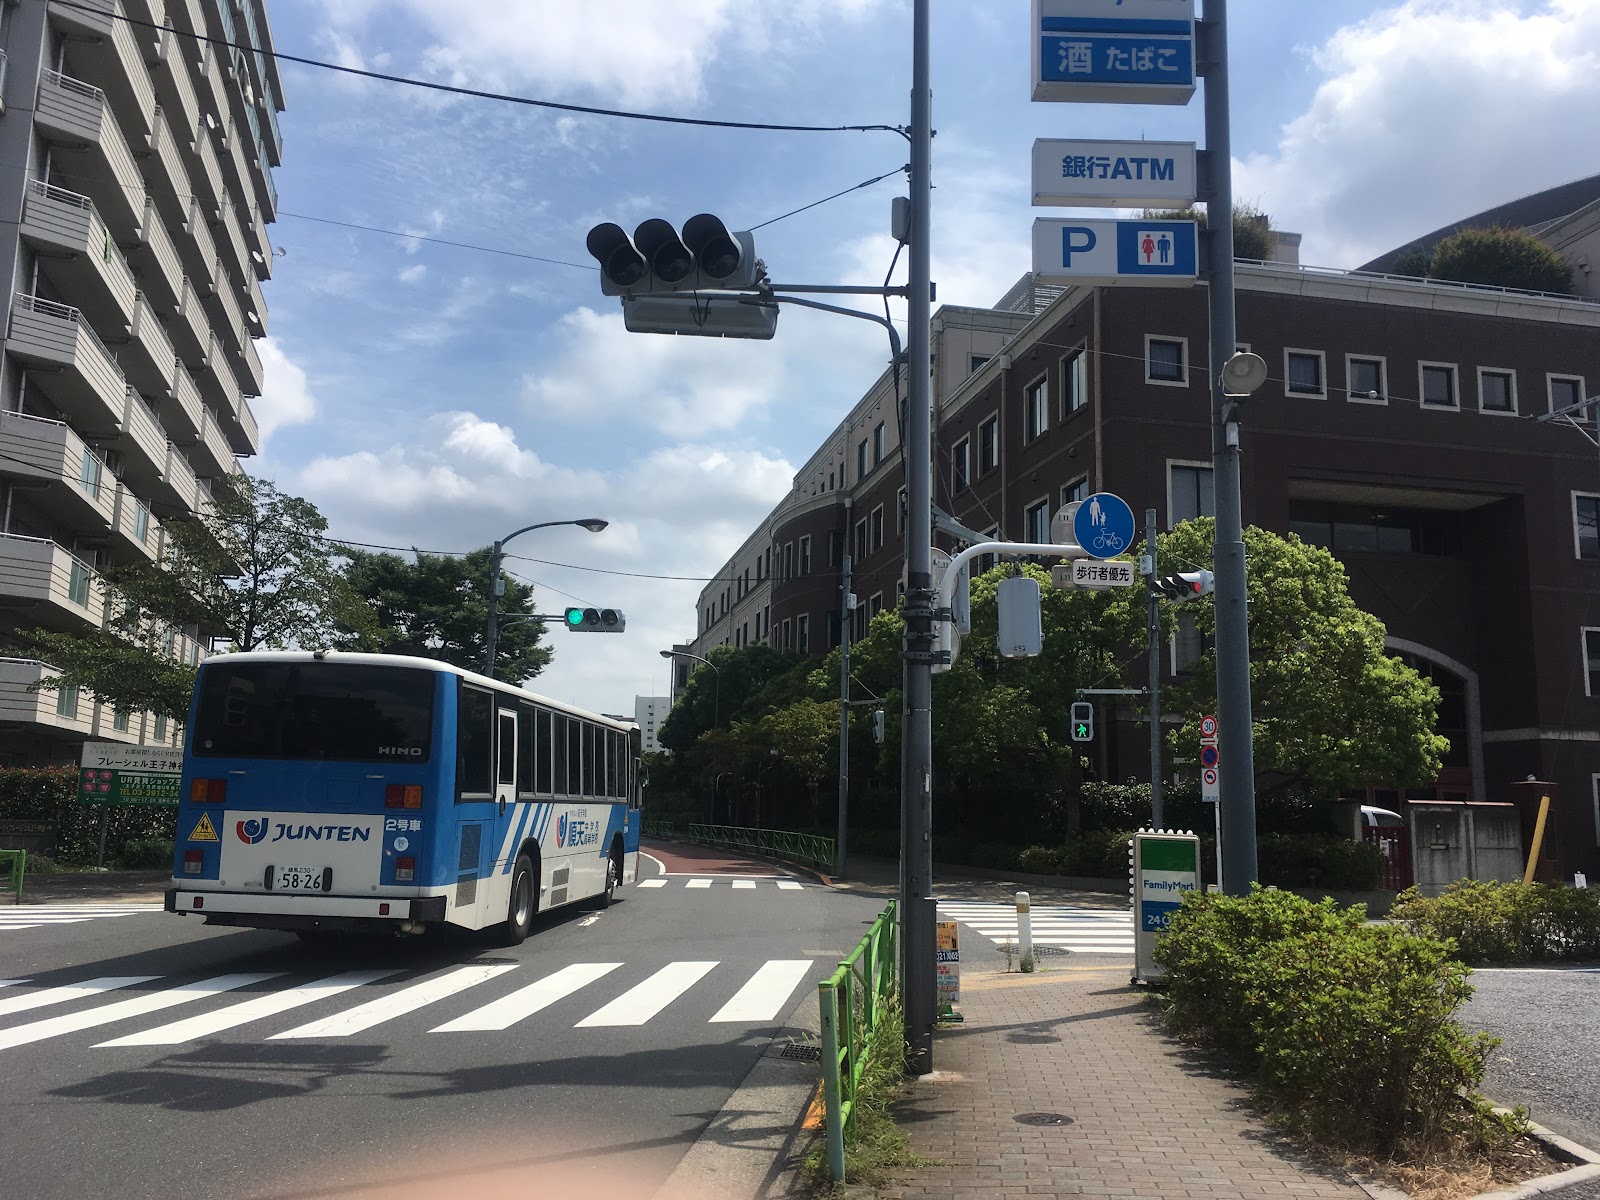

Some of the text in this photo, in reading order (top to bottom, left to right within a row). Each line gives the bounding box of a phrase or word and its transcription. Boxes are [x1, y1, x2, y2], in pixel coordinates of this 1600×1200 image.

[1058, 40, 1178, 74] 酒 たばこ
[1062, 155, 1175, 181] 銀行ATM
[1062, 226, 1097, 268] P
[1076, 566, 1130, 582] 歩行者優先
[1204, 721, 1214, 732] 30
[378, 746, 422, 756] HINO
[119, 787, 131, 796] TEL
[385, 818, 422, 832] 2号車
[272, 823, 371, 843] JUNTEN
[282, 873, 321, 889] 58-26
[1143, 879, 1195, 892] FamilyMart
[1147, 914, 1161, 925] 24
